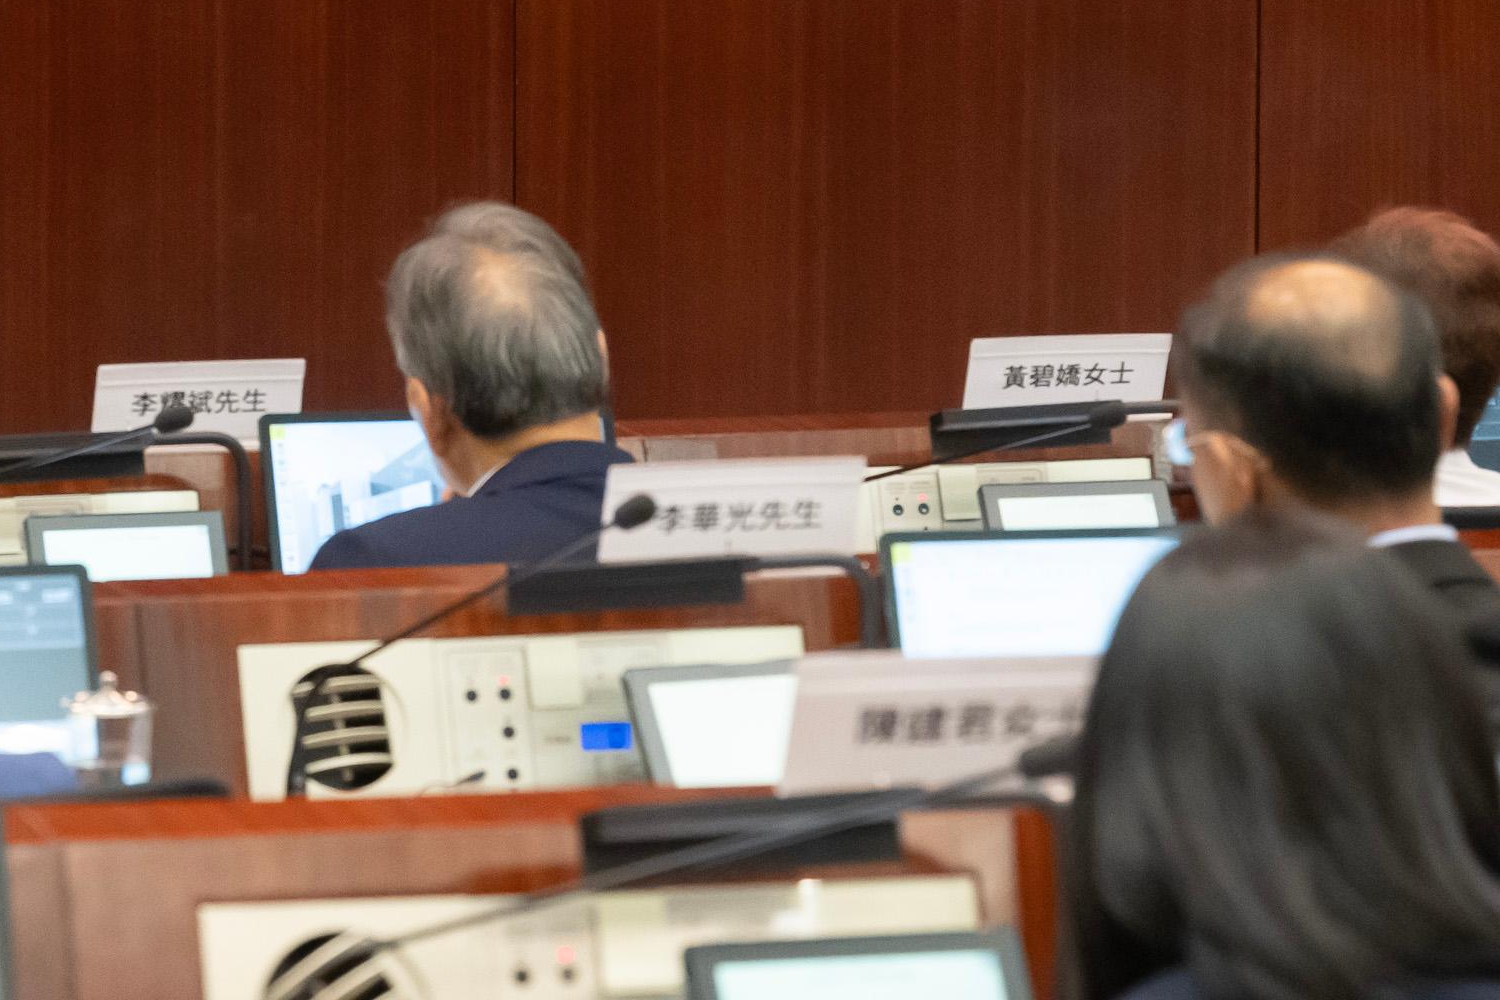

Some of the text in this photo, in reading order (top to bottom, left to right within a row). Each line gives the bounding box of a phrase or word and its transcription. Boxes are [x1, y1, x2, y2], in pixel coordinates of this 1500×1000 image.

[1003, 361, 1134, 390] 黃碧嬌女士
